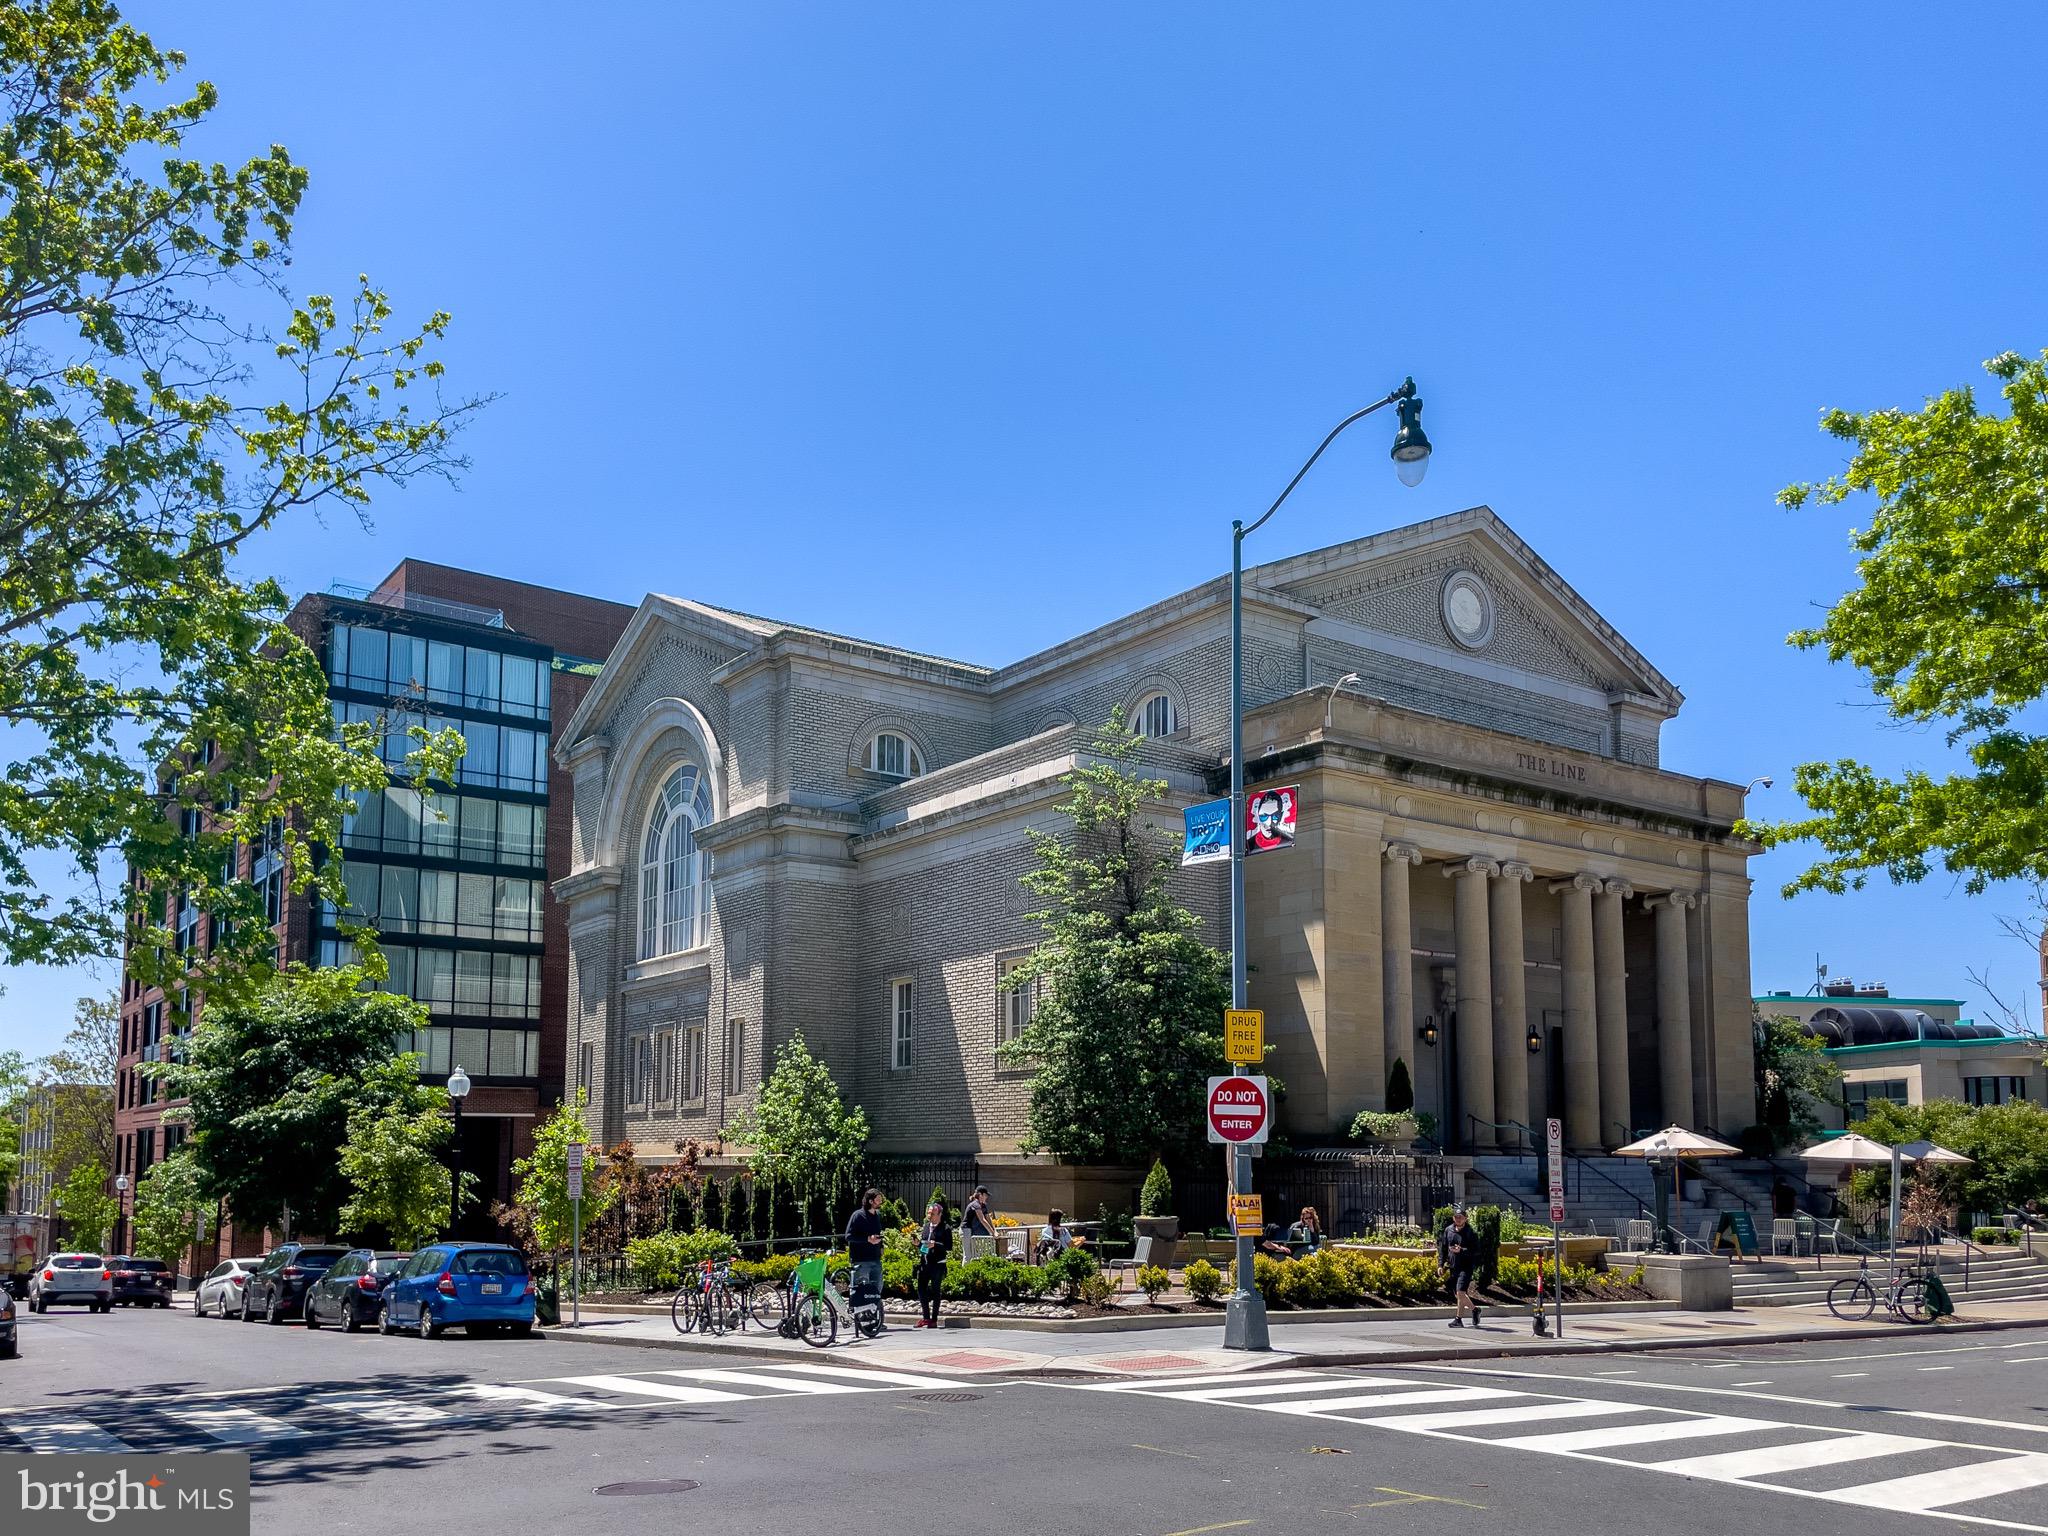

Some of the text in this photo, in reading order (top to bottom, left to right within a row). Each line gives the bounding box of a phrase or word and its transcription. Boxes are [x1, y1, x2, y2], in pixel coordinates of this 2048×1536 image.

[1517, 752, 1586, 781] THE LINE
[1190, 809, 1225, 825] LIVE YOUR
[1231, 1016, 1257, 1027] DRUG
[1233, 1030, 1256, 1041] FREE
[1233, 1044, 1255, 1055] ZONE
[1217, 1090, 1257, 1102] DO NOT
[1221, 1119, 1252, 1129] ENTER
